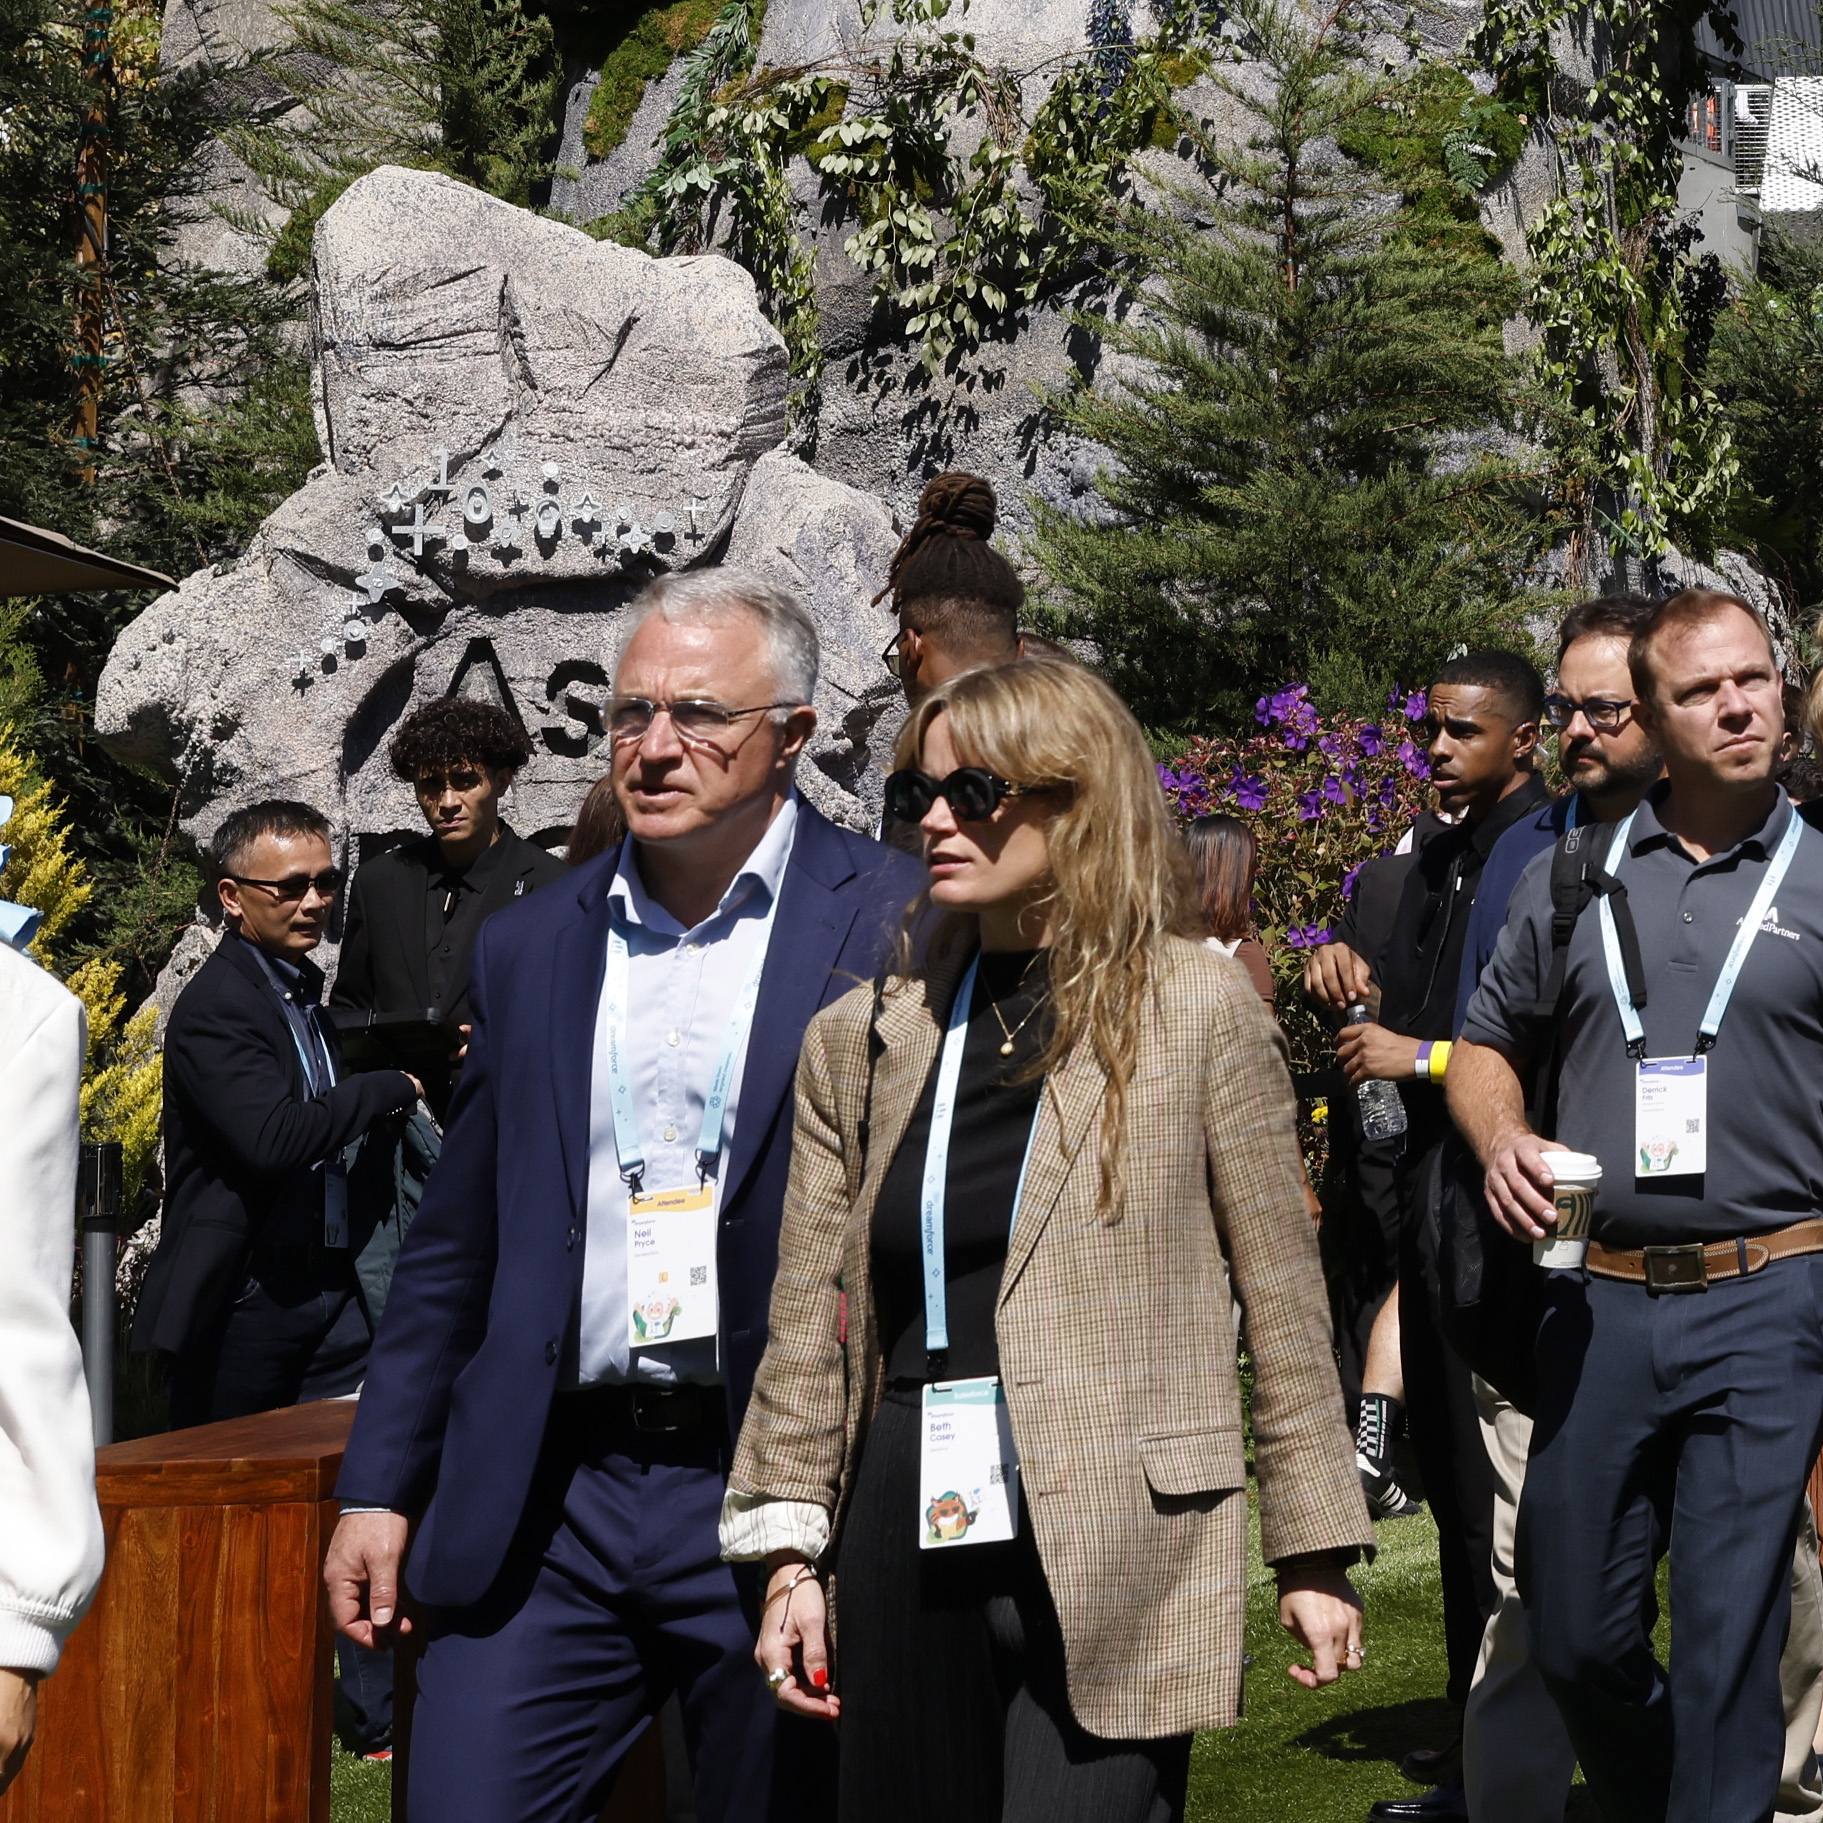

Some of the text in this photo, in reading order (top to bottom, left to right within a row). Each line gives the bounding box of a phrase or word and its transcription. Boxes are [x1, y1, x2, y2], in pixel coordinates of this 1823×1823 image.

[609, 1026, 618, 1075] dreamforce
[657, 1198, 686, 1207] Attendee
[925, 1200, 935, 1255] dreamforce
[634, 1229, 652, 1238] Neil
[634, 1239, 656, 1248] Pryce
[930, 1422, 952, 1432] Beth
[930, 1433, 956, 1442] Casey
